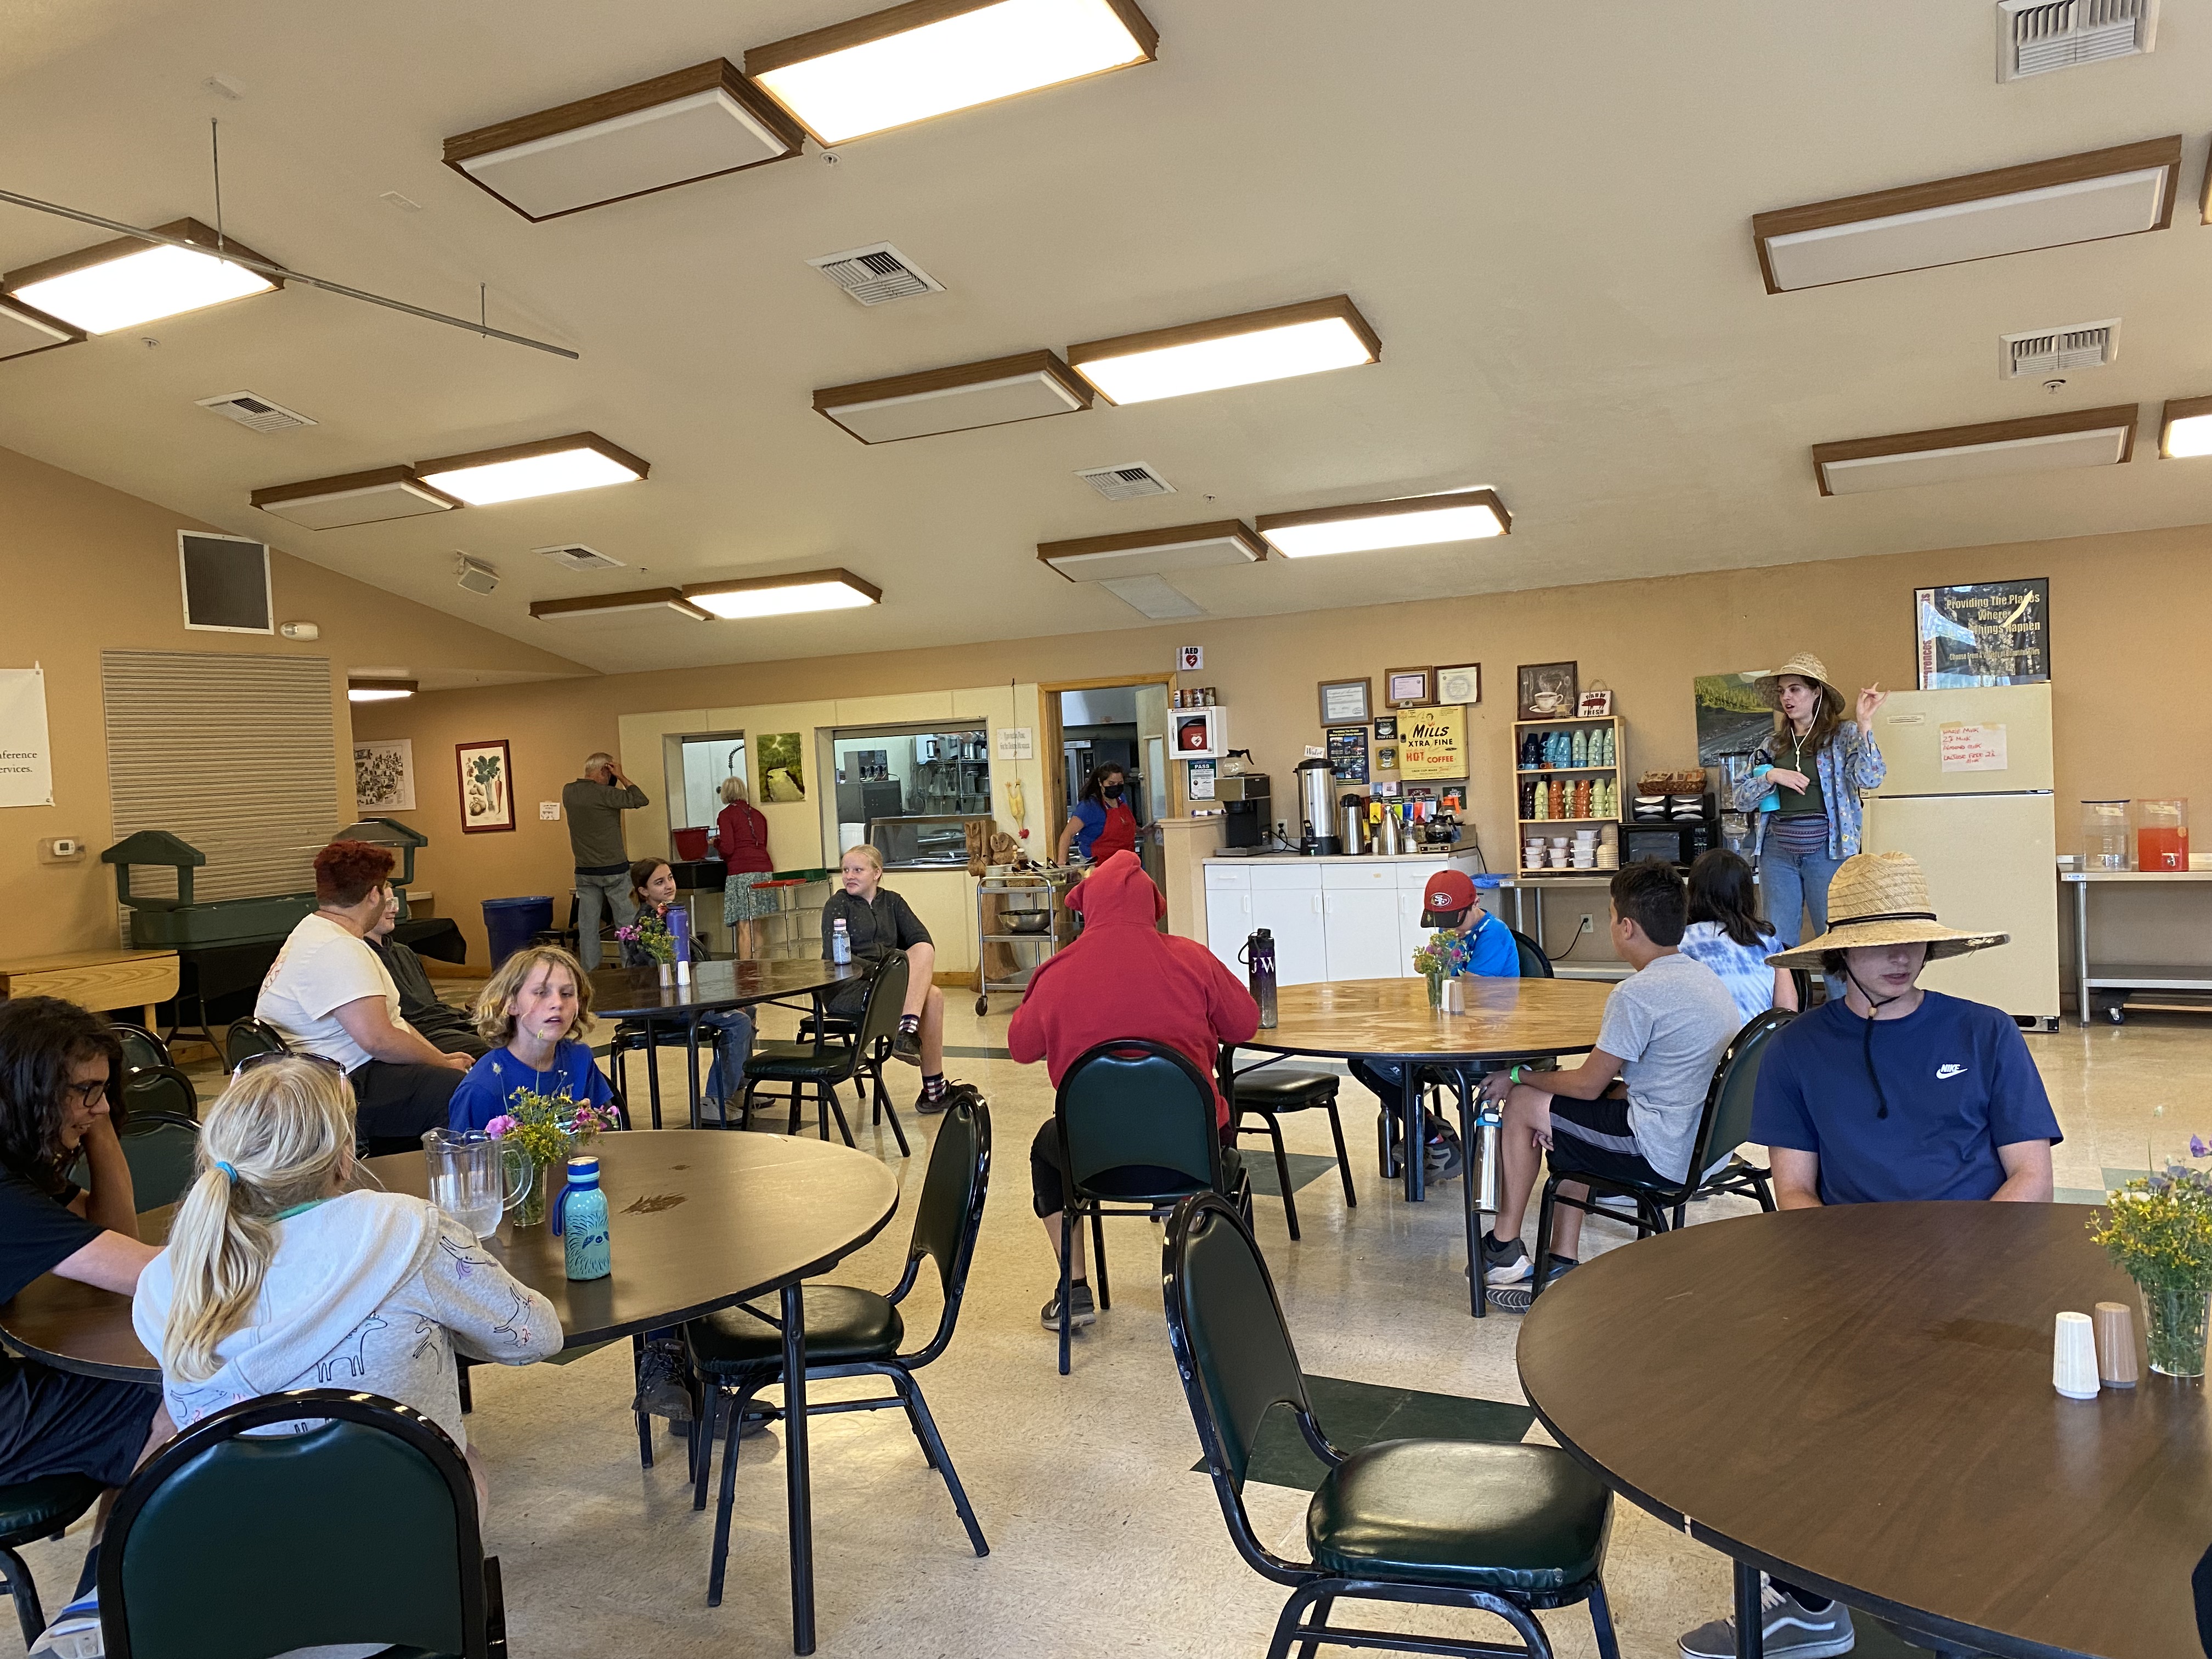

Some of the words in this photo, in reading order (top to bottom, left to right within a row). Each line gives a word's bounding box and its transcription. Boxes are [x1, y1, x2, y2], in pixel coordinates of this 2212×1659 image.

[1946, 597, 1989, 609] Providing
[1991, 595, 2007, 606] The
[2008, 592, 2040, 604] Plaes
[1977, 610, 2008, 620] Where
[1413, 724, 1449, 738] MILLS
[1406, 752, 1425, 762] HOT
[1940, 1064, 1961, 1073] NIKE
